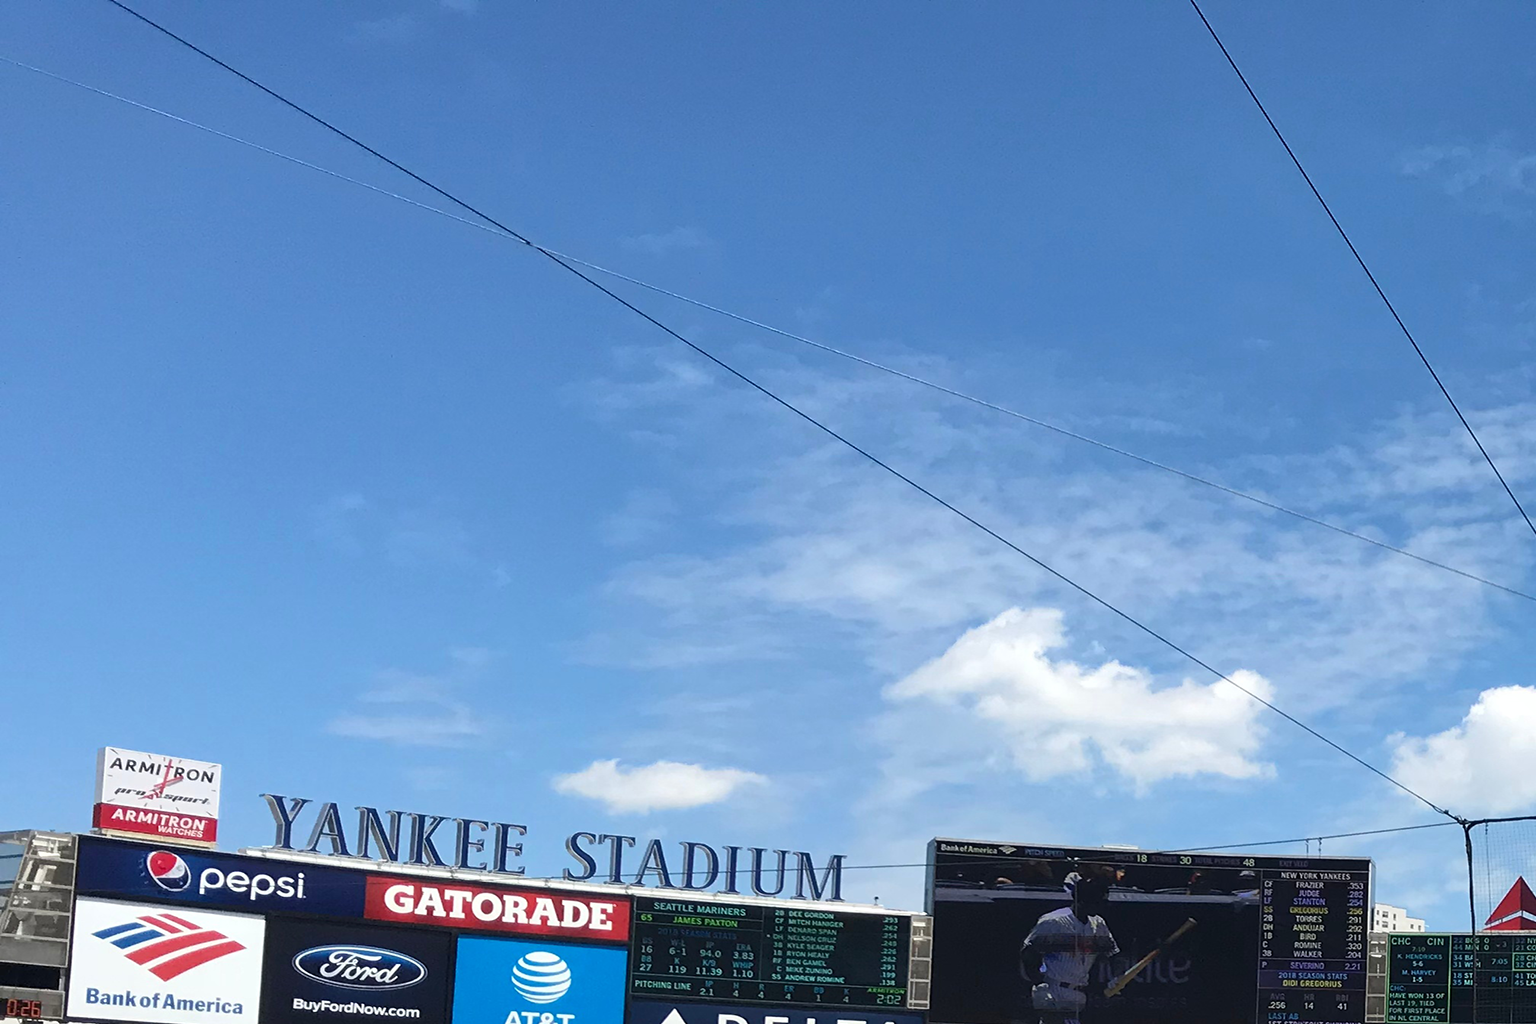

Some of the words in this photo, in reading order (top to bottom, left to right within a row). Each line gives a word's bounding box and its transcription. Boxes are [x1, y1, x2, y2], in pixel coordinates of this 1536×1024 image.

[110, 757, 214, 784] ARMITRON
[111, 808, 208, 831] ARMITRON
[158, 826, 203, 838] WATCHES
[260, 793, 527, 875] YANKEE
[563, 830, 847, 902] STADIUM
[940, 844, 959, 852] Bank
[967, 846, 998, 855] America
[1320, 873, 1351, 881] YANKEES
[199, 872, 305, 901] pepsi
[1295, 881, 1324, 889] FRAZIER
[384, 884, 614, 932] GATORADE
[654, 902, 694, 913] SEATTLE
[697, 905, 746, 916] MARINERS
[673, 916, 702, 925] JAMES
[704, 917, 738, 928] PAXTON
[1391, 937, 1411, 946] CHC
[1426, 938, 1444, 946] CIN
[319, 949, 402, 985] Ford
[1290, 962, 1324, 970] SEVERINO
[635, 980, 672, 989] PITCHING
[1300, 980, 1342, 988] GREGORIUS
[86, 987, 137, 1007] Bank
[140, 992, 162, 1009] of
[162, 993, 243, 1015] America
[293, 998, 420, 1019] BuyFordNow.com
